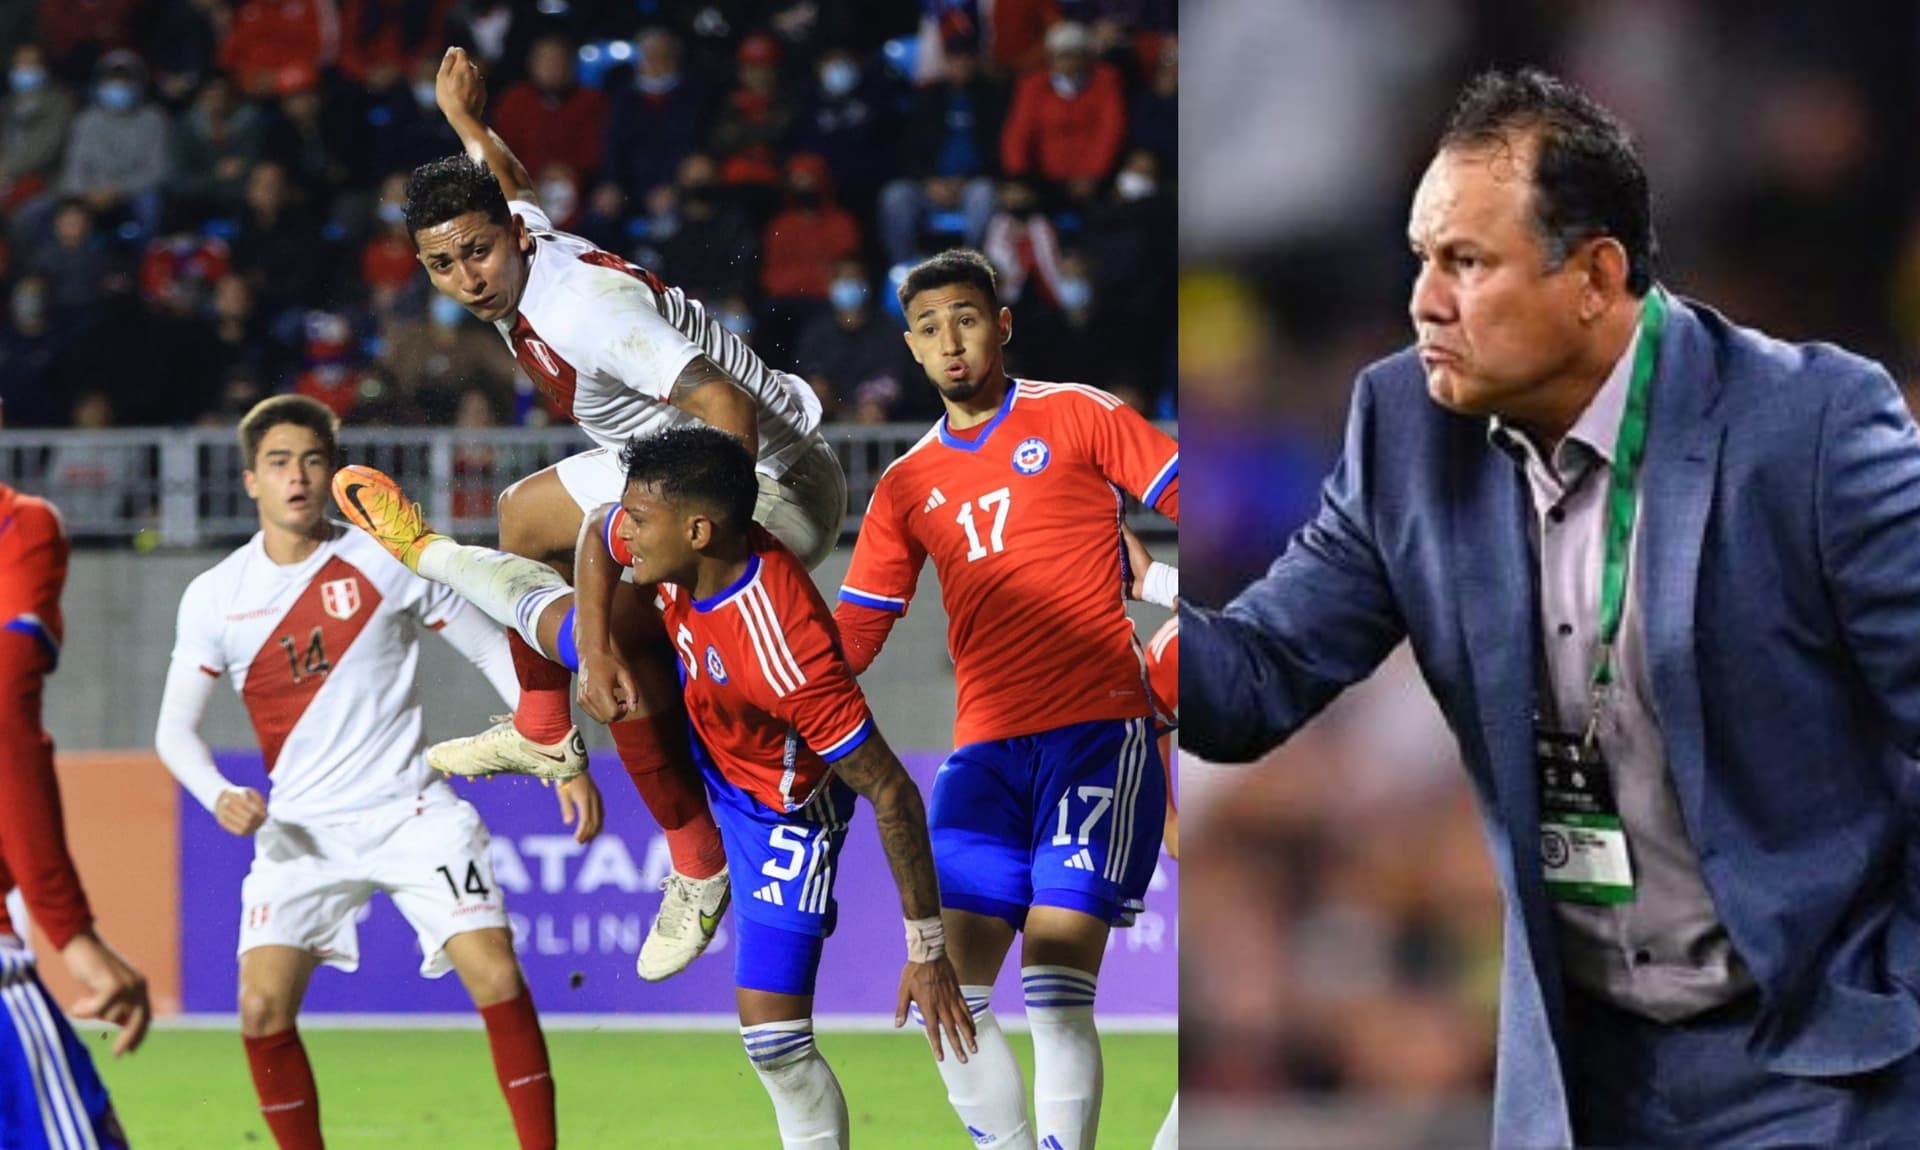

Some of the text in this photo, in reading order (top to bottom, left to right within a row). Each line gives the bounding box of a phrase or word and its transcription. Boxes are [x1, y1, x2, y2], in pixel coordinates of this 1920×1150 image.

[955, 486, 1011, 563] 17
[279, 626, 329, 683] 14
[1052, 785, 1114, 847] 17
[435, 859, 490, 903] 14
[490, 834, 668, 894] ATA
[761, 824, 807, 882] 5
